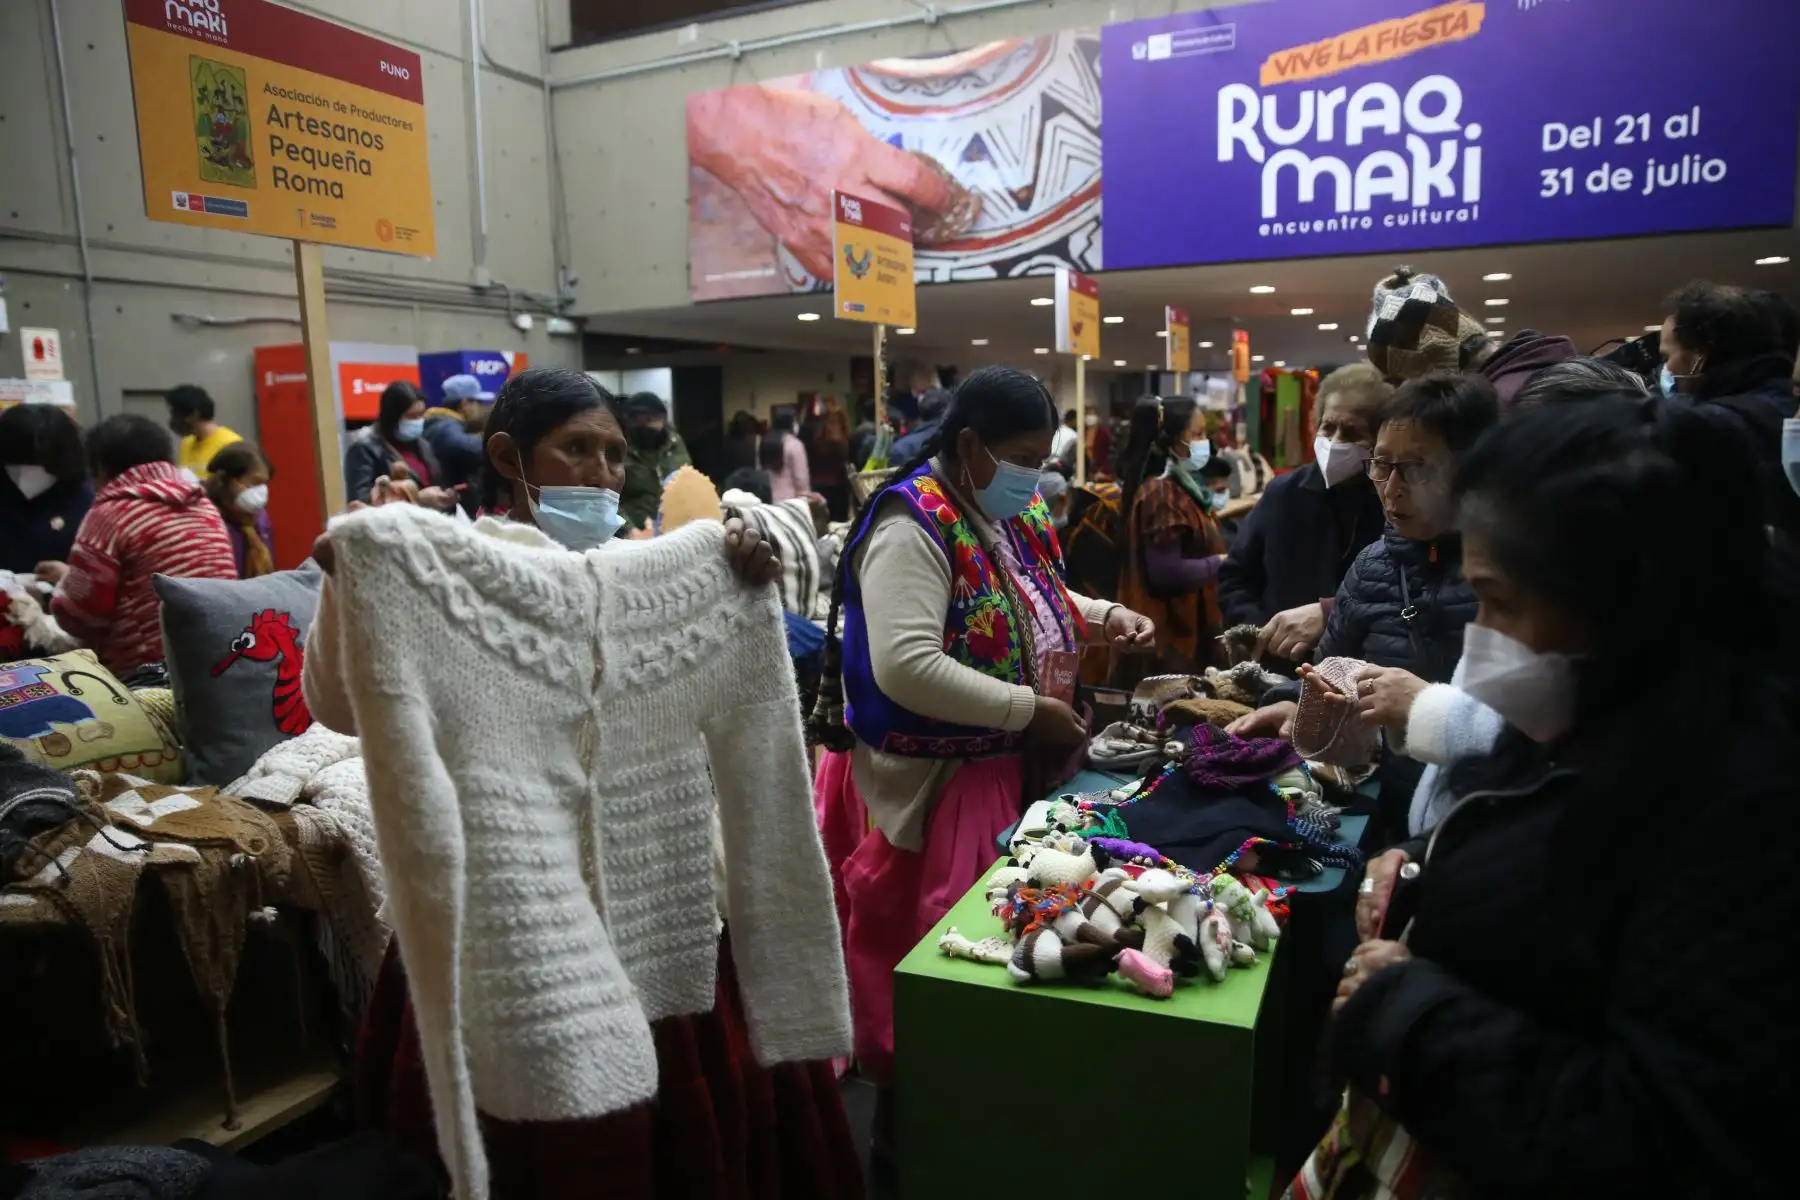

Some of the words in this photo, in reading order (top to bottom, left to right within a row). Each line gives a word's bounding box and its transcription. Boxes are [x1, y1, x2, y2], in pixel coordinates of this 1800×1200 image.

[1275, 43, 1332, 76] VIVE
[1338, 36, 1369, 61] LA
[1376, 10, 1469, 53] FIESTA
[380, 60, 410, 80] PUNO
[263, 82, 330, 108] Asociación
[333, 100, 347, 114] de
[350, 104, 413, 132] Productores
[266, 103, 384, 151] Artesanos
[1542, 116, 1602, 152] Del
[1614, 112, 1651, 145] 21
[1663, 105, 1700, 140] al
[269, 134, 372, 176] Pequeña
[1540, 166, 1574, 198] 31
[1585, 162, 1634, 193] de
[1642, 153, 1727, 196] julio
[272, 165, 344, 199] Roma
[1258, 213, 1373, 237] encuentro
[1383, 204, 1479, 228] cultural
